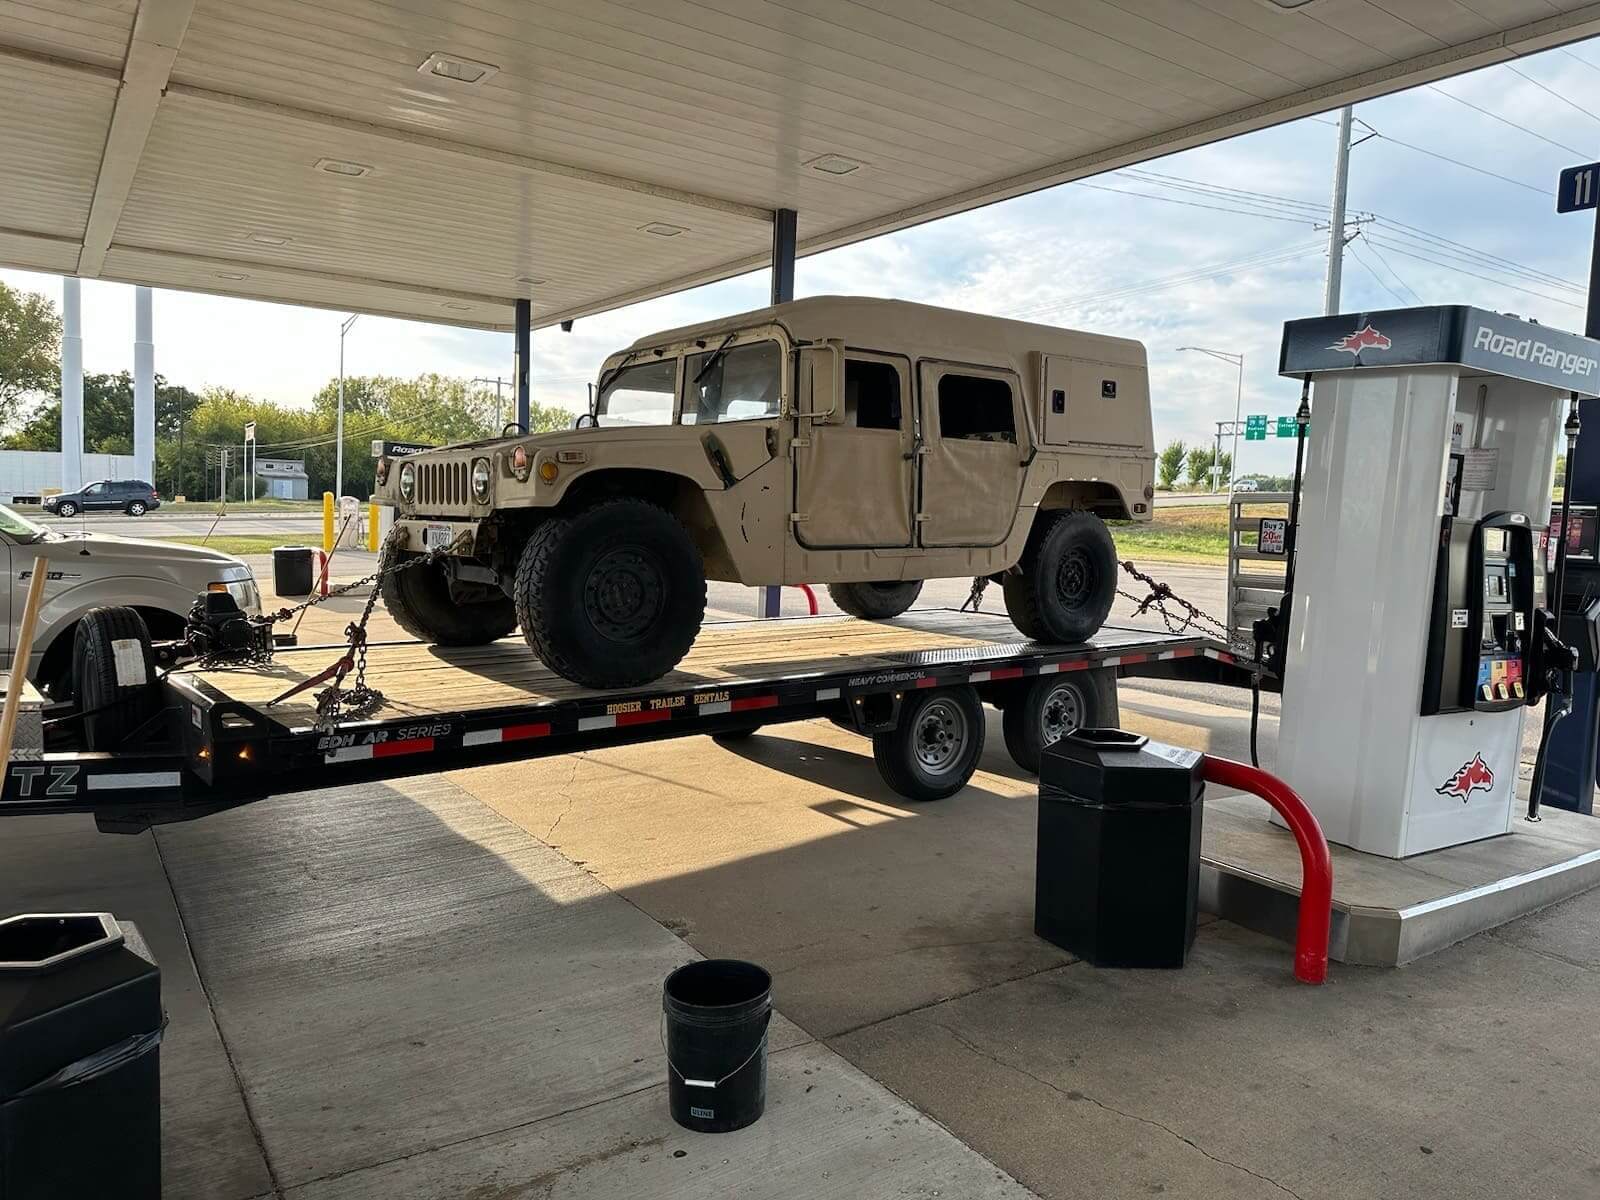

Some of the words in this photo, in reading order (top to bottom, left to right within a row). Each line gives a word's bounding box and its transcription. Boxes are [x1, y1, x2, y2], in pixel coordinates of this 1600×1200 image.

[1574, 169, 1592, 206] 11
[1473, 326, 1531, 361] Road
[1530, 341, 1598, 377] Ranger
[1264, 521, 1277, 531] Buy
[848, 675, 876, 687] HEAVY
[876, 671, 926, 684] COMMERCIAL
[606, 701, 642, 715] HOOSIER
[649, 696, 686, 710] TRAILER
[693, 691, 730, 704] RENTALS
[361, 730, 389, 745] AR
[396, 723, 452, 741] SERIES
[12, 765, 81, 797] TZ
[692, 1108, 713, 1117] ULINE
